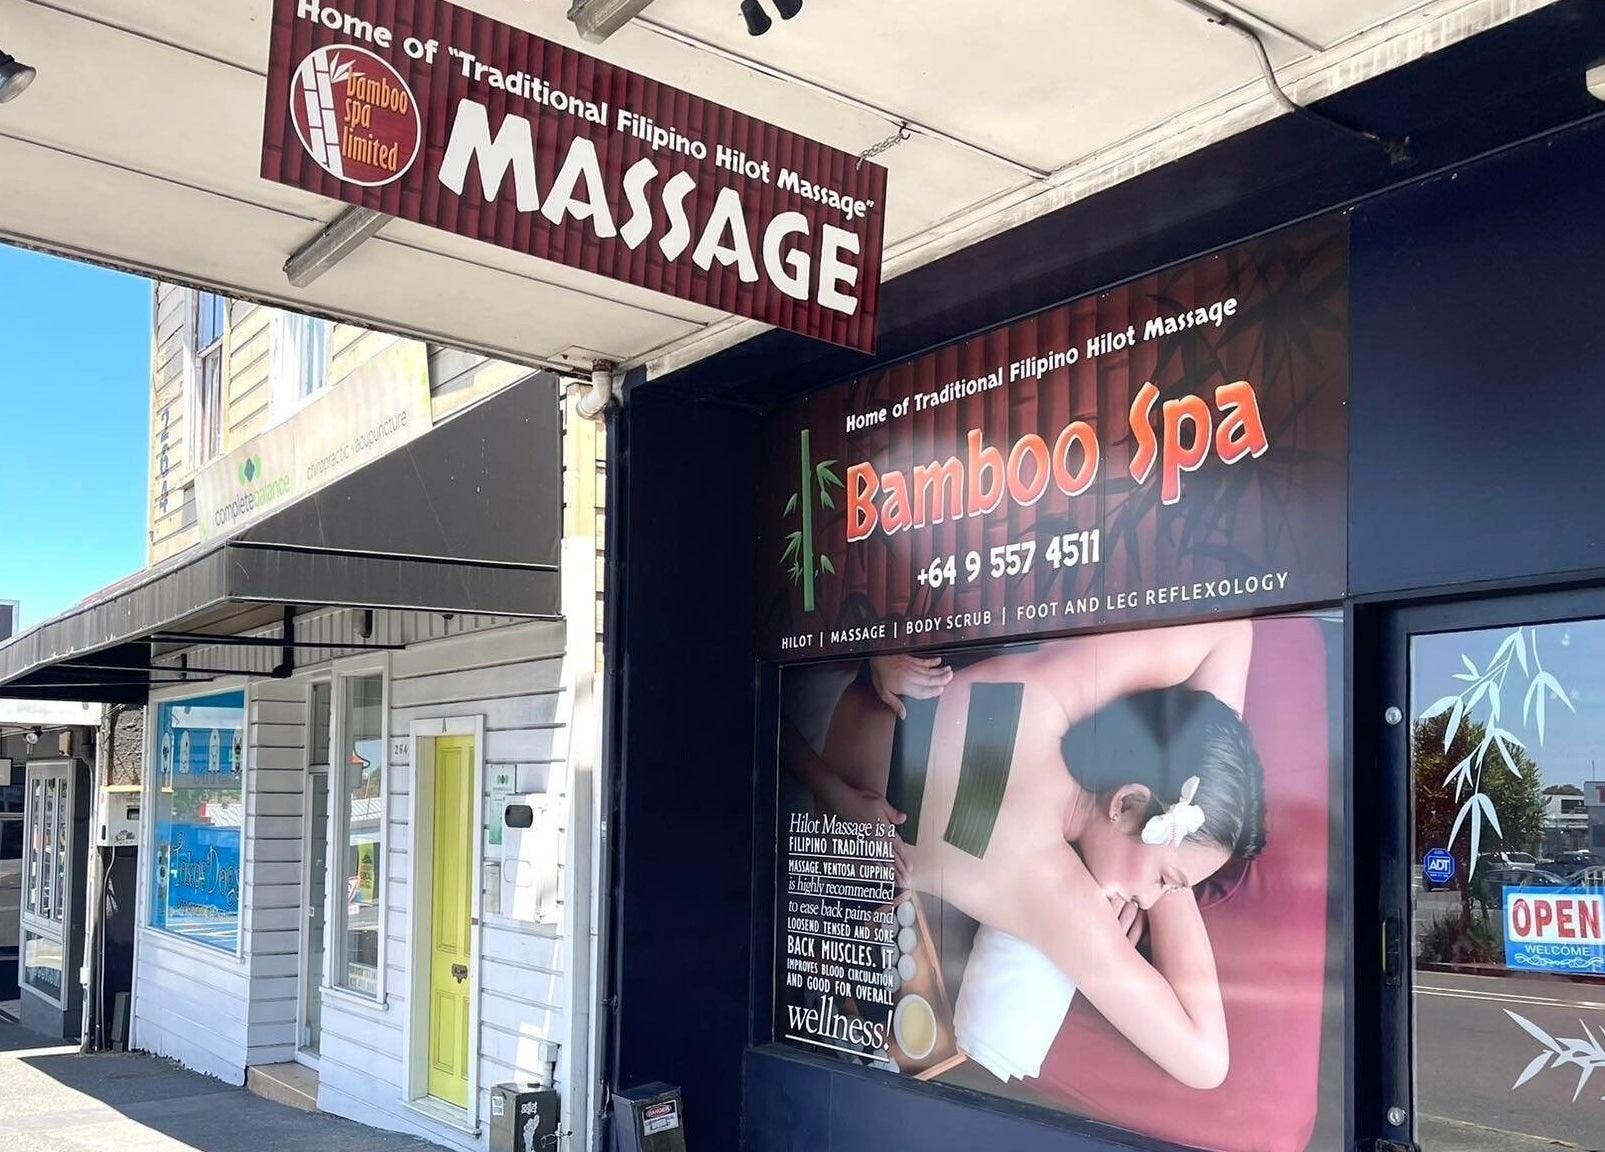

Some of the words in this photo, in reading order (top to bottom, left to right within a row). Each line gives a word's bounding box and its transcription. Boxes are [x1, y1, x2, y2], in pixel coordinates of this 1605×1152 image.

[297, 0, 392, 48] Home
[403, 37, 439, 64] of
[617, 108, 707, 160] Filipino
[715, 145, 771, 184] Hilot
[347, 67, 408, 115] bamboo
[344, 98, 370, 129] spa
[342, 127, 398, 172] limited
[438, 98, 860, 316] MASSAGE
[846, 407, 887, 432] Home
[892, 398, 909, 419] of
[914, 367, 1003, 411] Traditional
[1010, 347, 1079, 380] Filipino
[1086, 325, 1136, 358] Hilot
[1143, 297, 1238, 341] Massage
[354, 410, 408, 454] acupuncture
[847, 421, 1100, 543] Bamboo
[1129, 380, 1269, 506] Spa
[917, 555, 957, 588] +64
[965, 551, 981, 583] 9
[990, 540, 1036, 579] 557
[1045, 529, 1100, 569] 4511
[781, 634, 813, 649] HILOT
[830, 624, 886, 644] MASSAGE
[906, 616, 942, 635] BODY
[946, 610, 992, 629] SCRUB
[1017, 601, 1058, 620] FOOT
[1064, 597, 1099, 615] AND
[1106, 591, 1138, 610] LEG
[1145, 571, 1289, 605] REFLEXOLOGY
[789, 812, 820, 834] Hilot
[821, 813, 873, 843] Massage
[875, 818, 885, 837] is
[887, 822, 896, 838] a
[789, 836, 827, 854] FILIPINO
[832, 838, 895, 858] TRADITIONAL
[823, 862, 856, 877] VENTOSA
[859, 865, 895, 880] CUPPING
[1428, 859, 1450, 871] ADT
[788, 876, 796, 891] is
[797, 876, 824, 897] highly
[825, 881, 895, 900] recommended
[788, 900, 798, 913] to
[800, 903, 819, 916] ease
[820, 899, 843, 919] back
[844, 905, 872, 923] pains
[873, 907, 894, 924] and
[1512, 898, 1602, 939] OPEN
[788, 917, 820, 933] LOOSEND
[823, 921, 851, 937] TENSED
[853, 925, 871, 940] AND
[874, 929, 895, 943] SORE
[787, 935, 815, 958] BACK
[821, 940, 876, 968] MUSCLES.
[882, 948, 894, 970] IT
[1524, 945, 1591, 957] WELCOME
[786, 972, 803, 988] AND
[807, 976, 831, 993] GOOD
[835, 981, 852, 997] FOR
[856, 985, 894, 1006] OVERALL
[787, 958, 818, 974] IMPROVES
[821, 963, 845, 979] BLOOD
[848, 968, 894, 987] CIRCULATION
[787, 995, 894, 1051] wellness!
